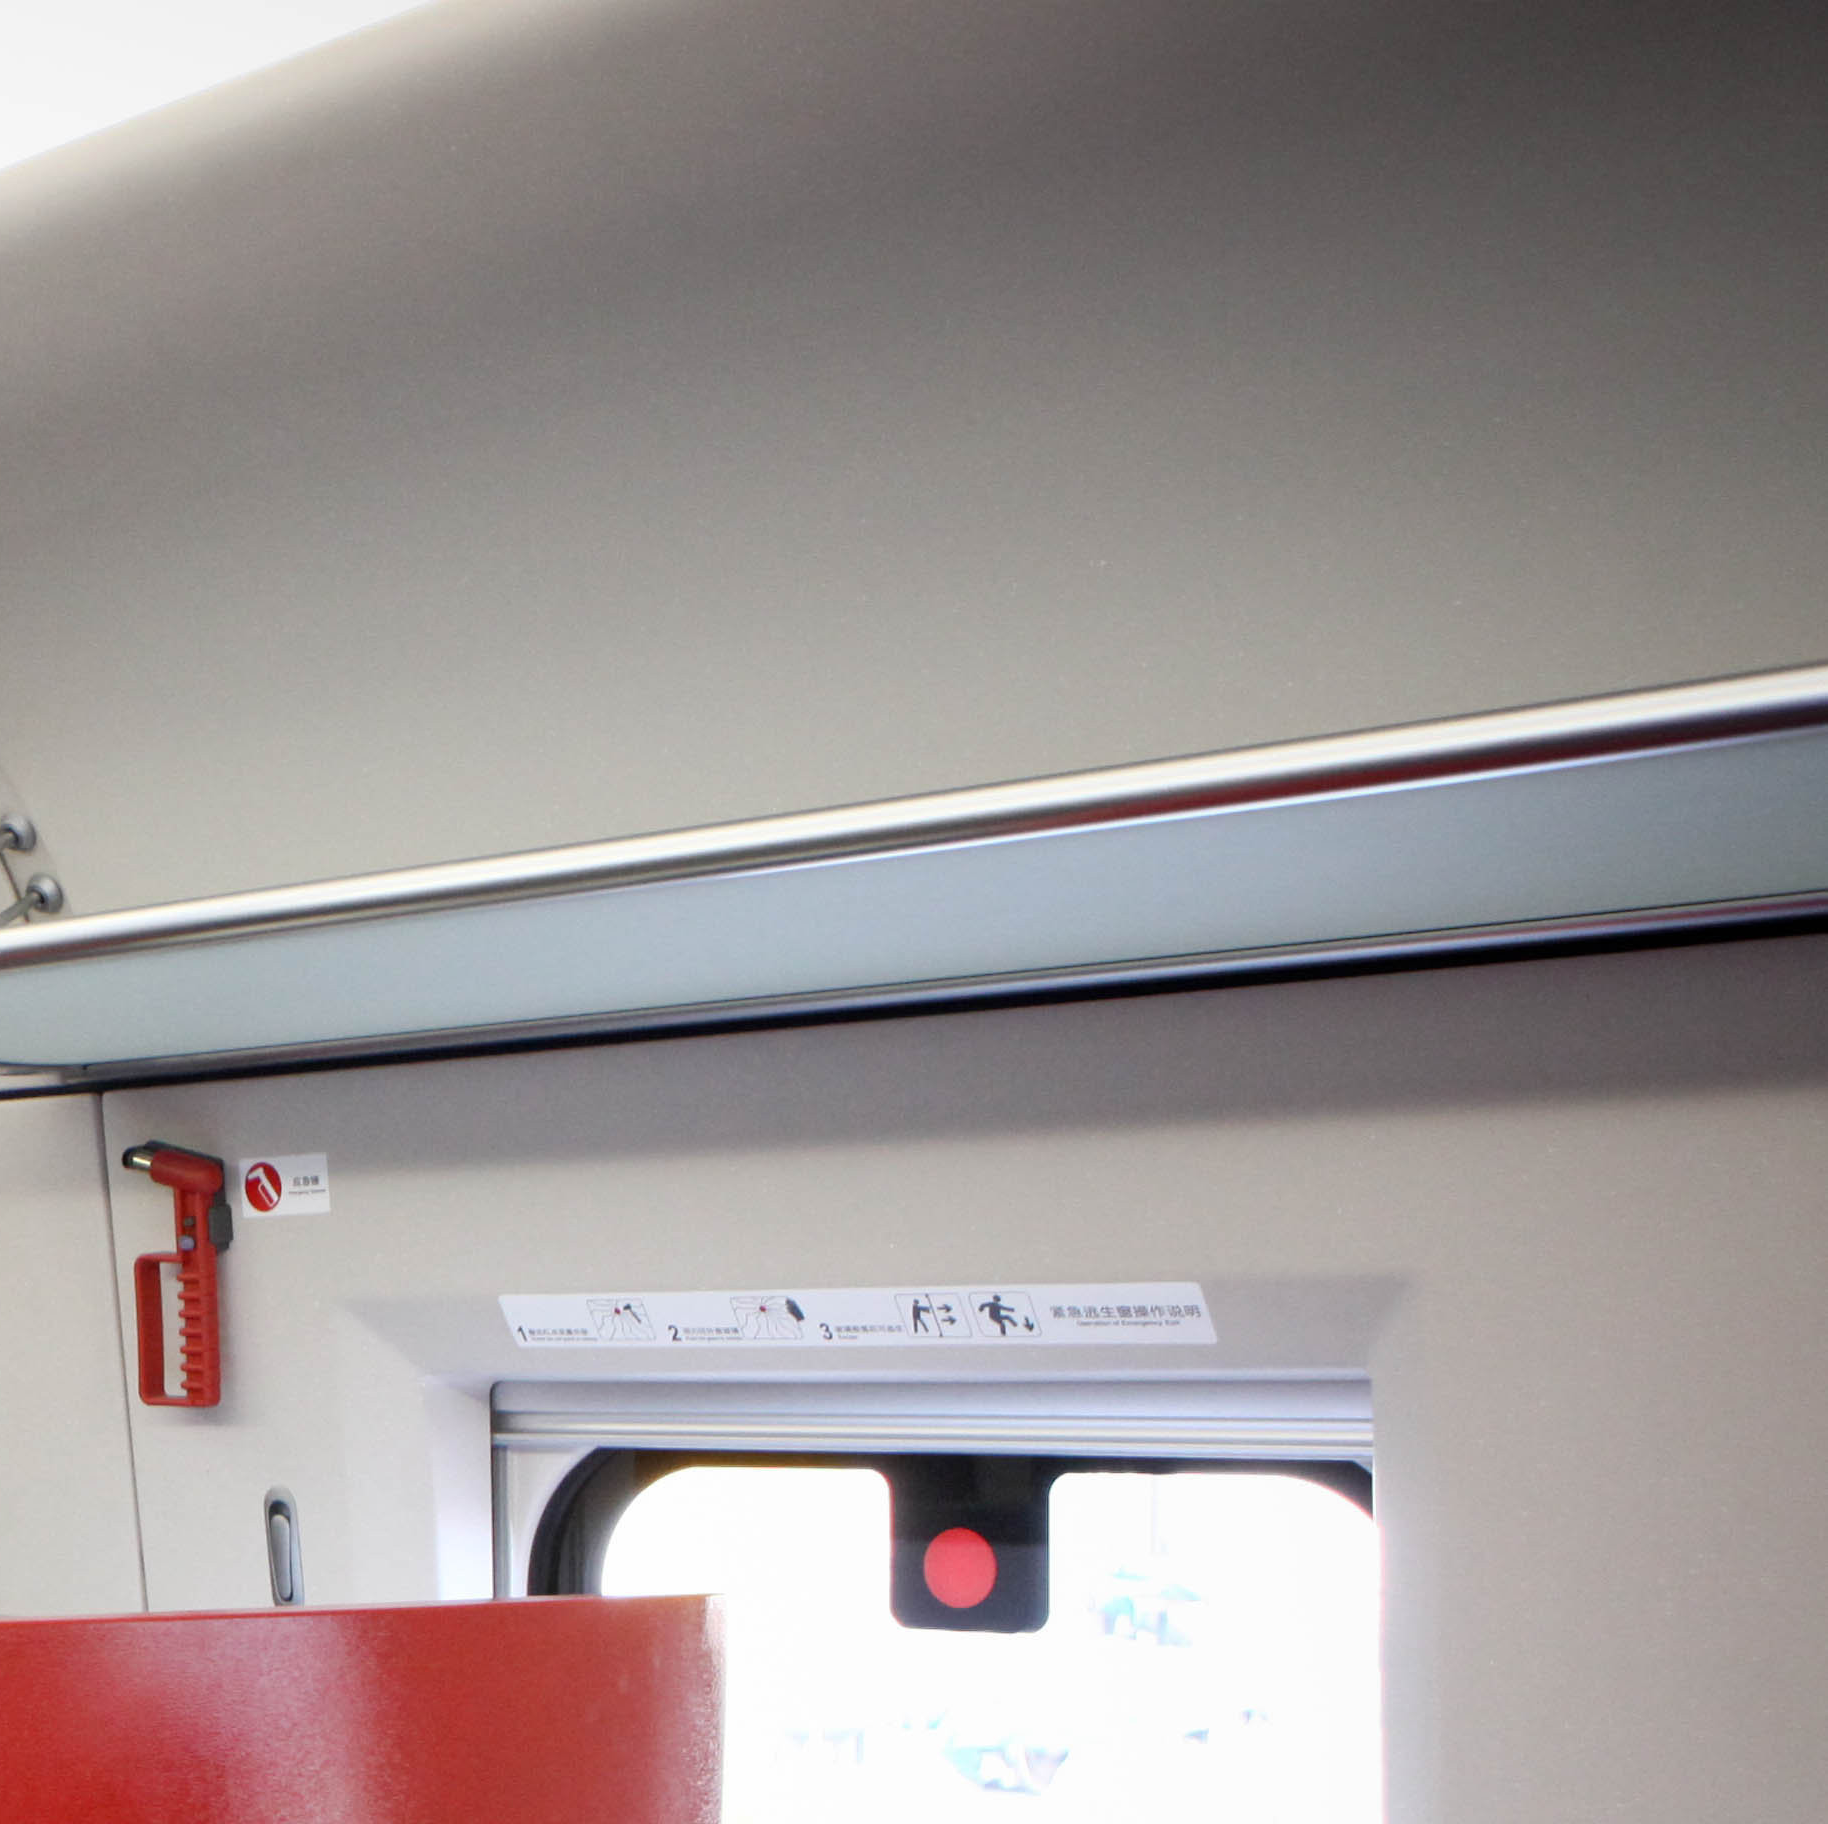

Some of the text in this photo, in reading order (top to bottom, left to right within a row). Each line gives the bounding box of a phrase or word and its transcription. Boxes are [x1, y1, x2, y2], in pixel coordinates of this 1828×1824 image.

[517, 1326, 528, 1342] 1
[667, 1324, 682, 1341] 2
[818, 1322, 833, 1340] 3
